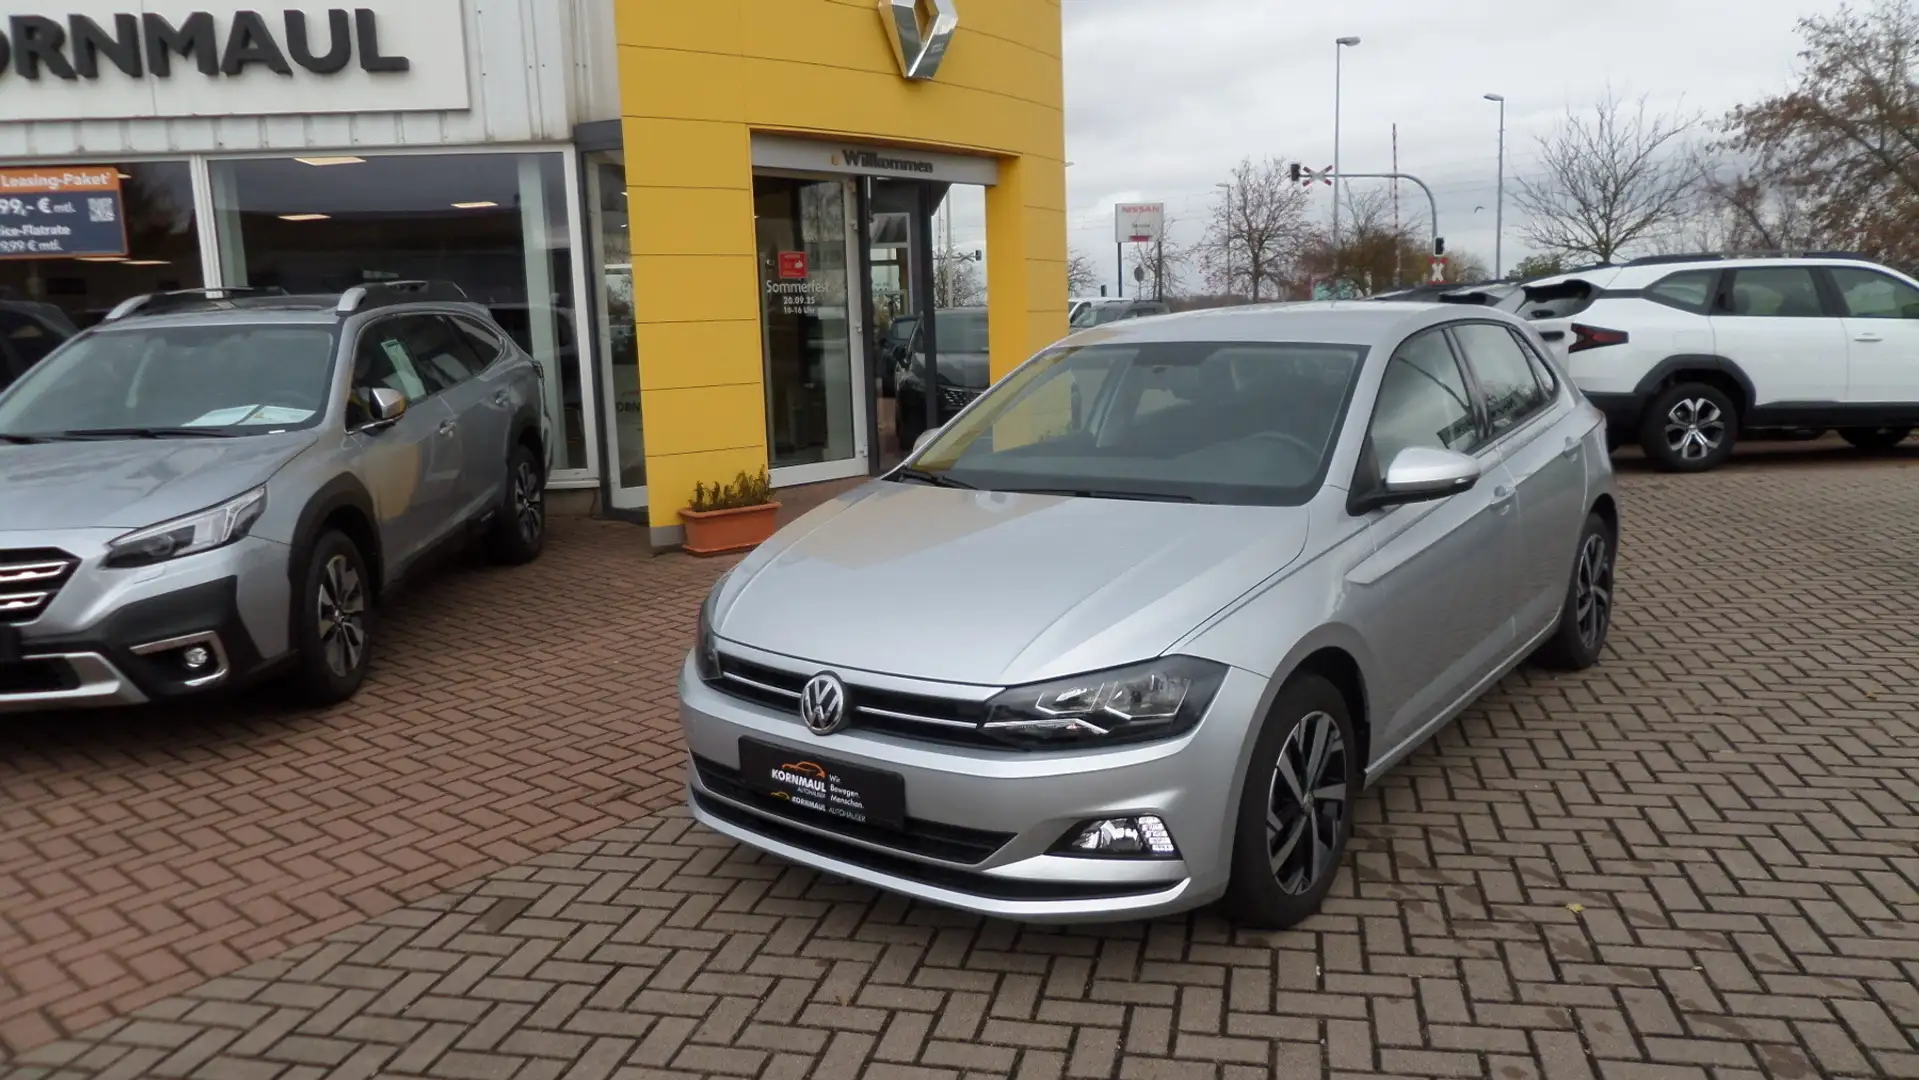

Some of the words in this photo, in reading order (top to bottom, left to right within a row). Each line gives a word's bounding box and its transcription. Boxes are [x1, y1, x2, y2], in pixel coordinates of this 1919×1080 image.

[0, 8, 410, 81] RNMAUL
[842, 149, 933, 173] Willkommen
[1121, 205, 1160, 214] NISSAN
[766, 280, 830, 293] Sommerfest
[771, 768, 827, 793] KORNMAUL
[791, 795, 826, 812] KORNMAUL
